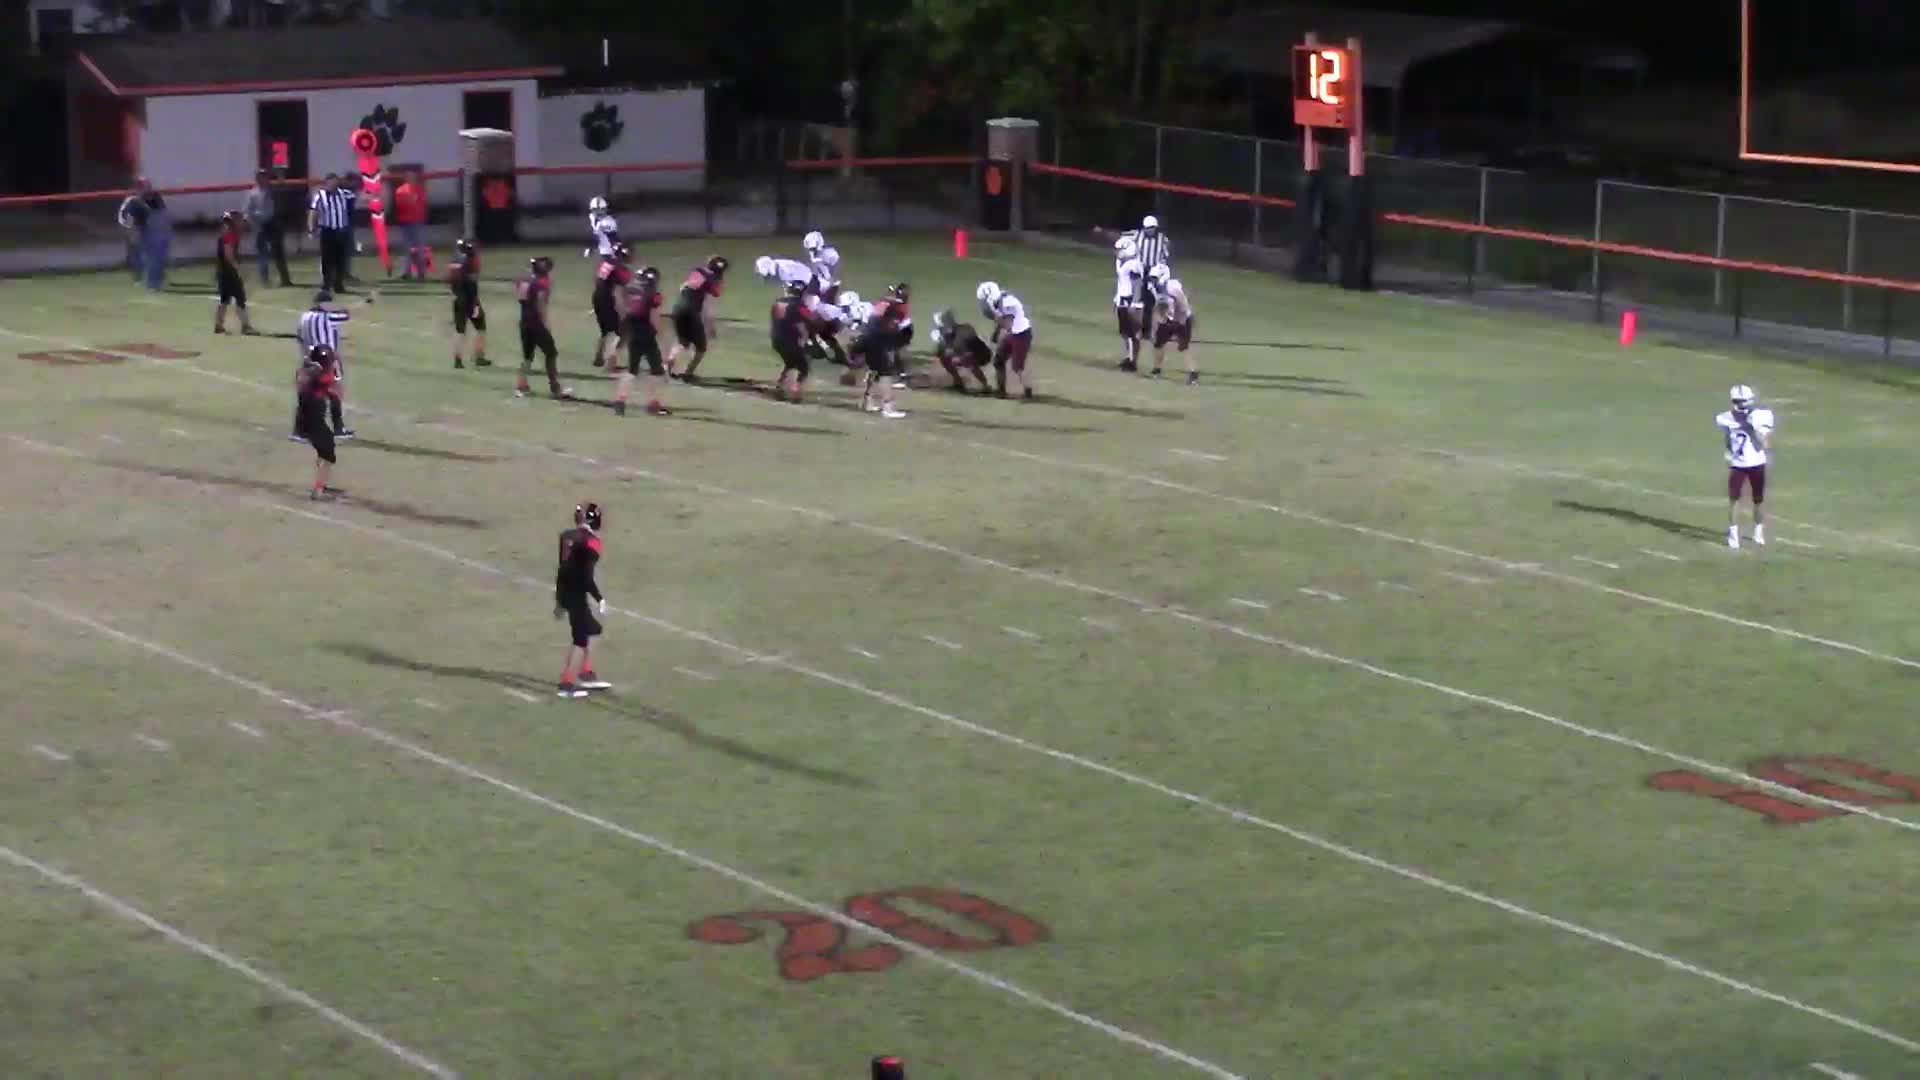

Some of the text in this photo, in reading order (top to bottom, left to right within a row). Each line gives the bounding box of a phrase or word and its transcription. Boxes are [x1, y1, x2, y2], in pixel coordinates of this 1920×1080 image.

[1309, 50, 1341, 105] 12
[1645, 754, 1920, 825] 10
[687, 887, 1050, 982] 20
